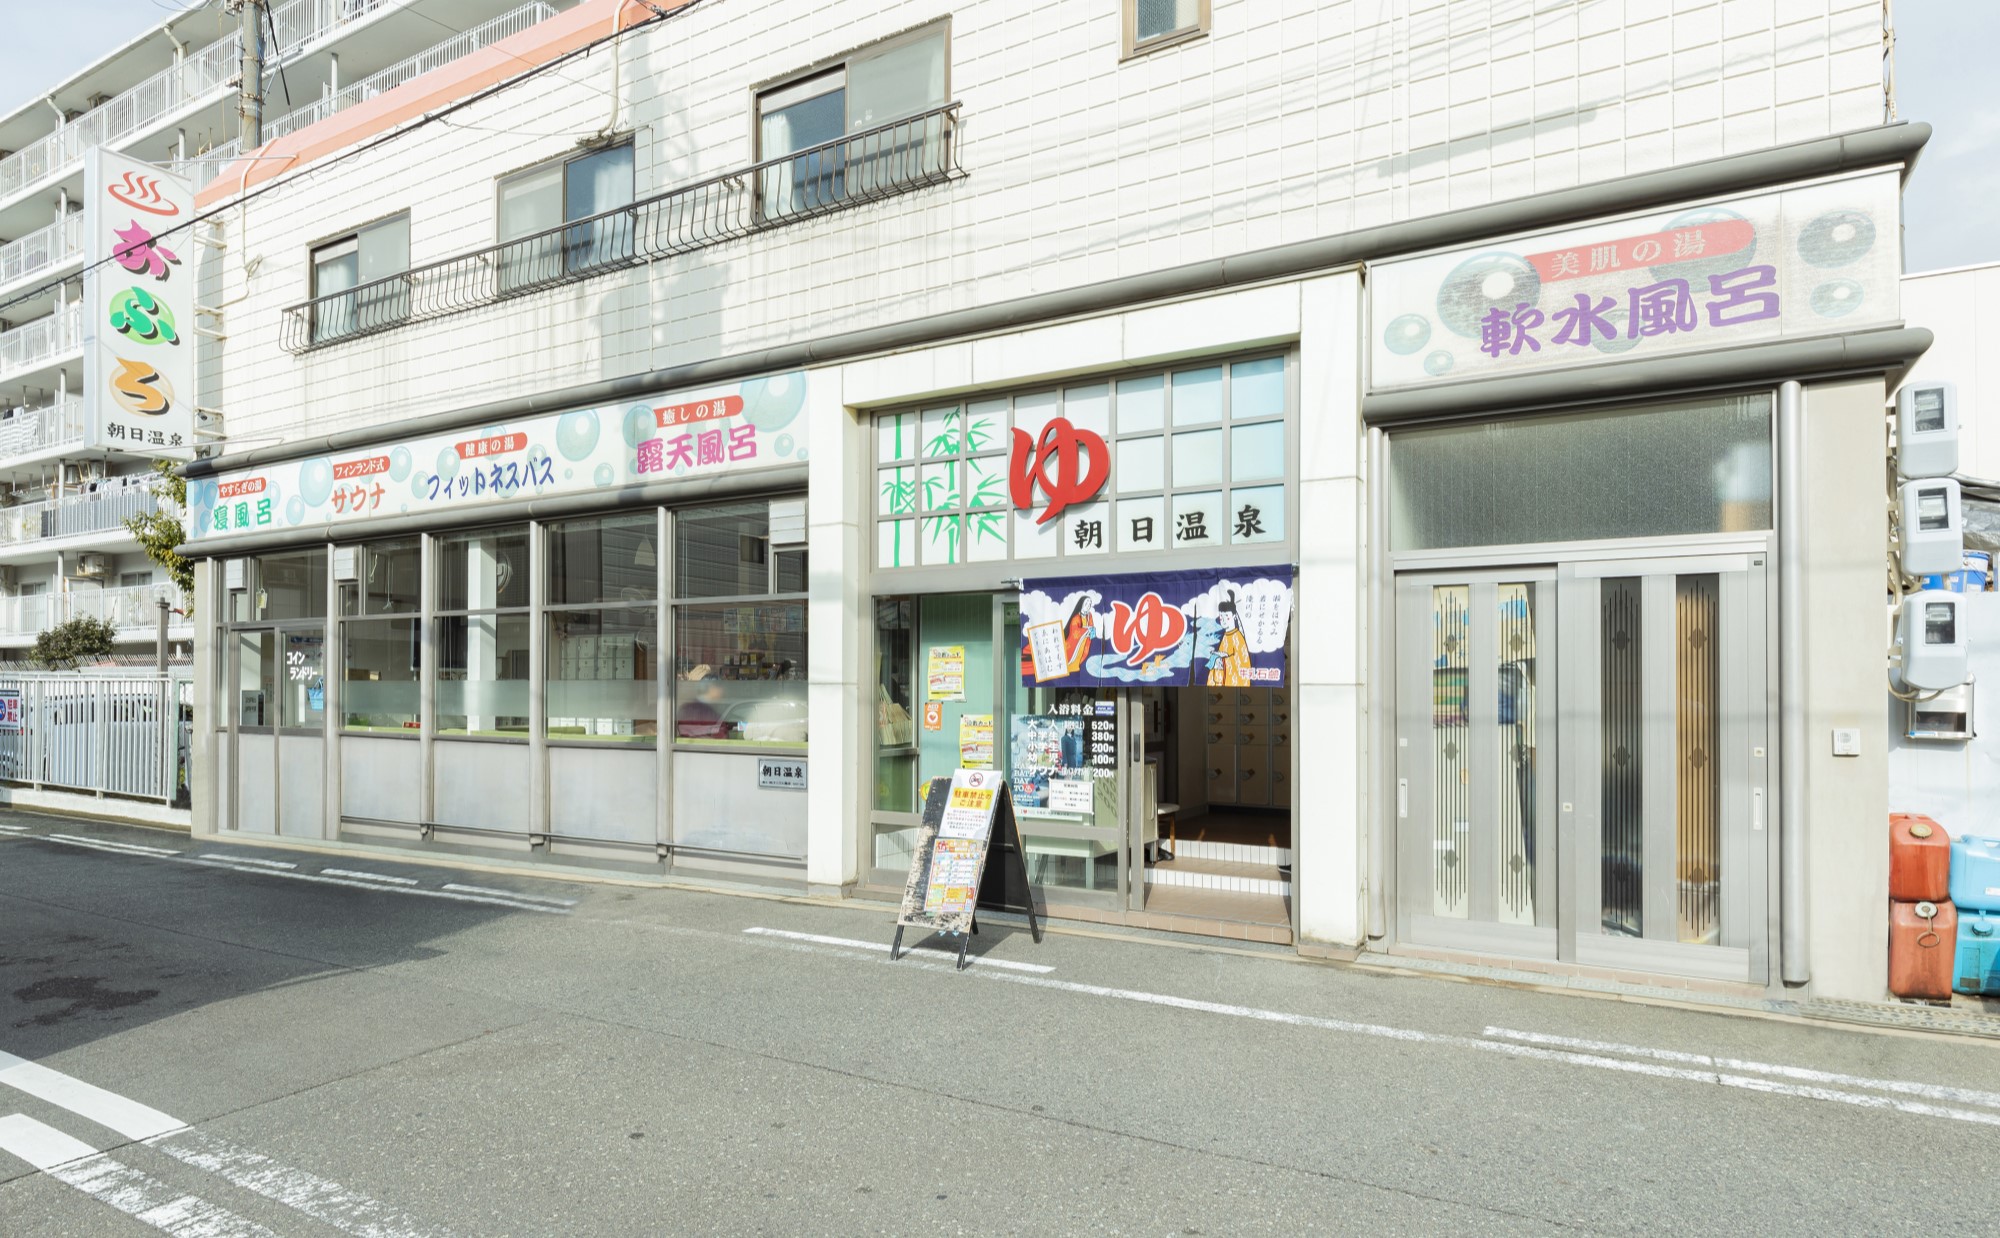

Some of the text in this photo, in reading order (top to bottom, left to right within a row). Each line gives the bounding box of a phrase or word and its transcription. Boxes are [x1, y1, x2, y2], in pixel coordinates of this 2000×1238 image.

[1549, 229, 1706, 279] 美肌の湯
[1479, 264, 1781, 358] 軟水風呂
[663, 400, 726, 425] 癒しの湯
[107, 422, 183, 447] 朝日温泉
[465, 436, 515, 457] 健康の湯
[637, 424, 757, 474] 露天風呂
[335, 459, 385, 478] フィンランド式
[427, 456, 555, 501] フィットネスバス
[1009, 416, 1110, 525] ゆ
[220, 481, 262, 497] やすらぎの湯
[331, 481, 386, 513] サウナ
[213, 498, 272, 531] 寝風呂
[1074, 504, 1266, 549] 朝日温泉
[1111, 594, 1188, 665] ゆ
[286, 651, 305, 665] コイン
[290, 666, 318, 680] ランドリー
[1048, 704, 1093, 715] 入浴料金
[762, 765, 803, 778] 朝日温泉
